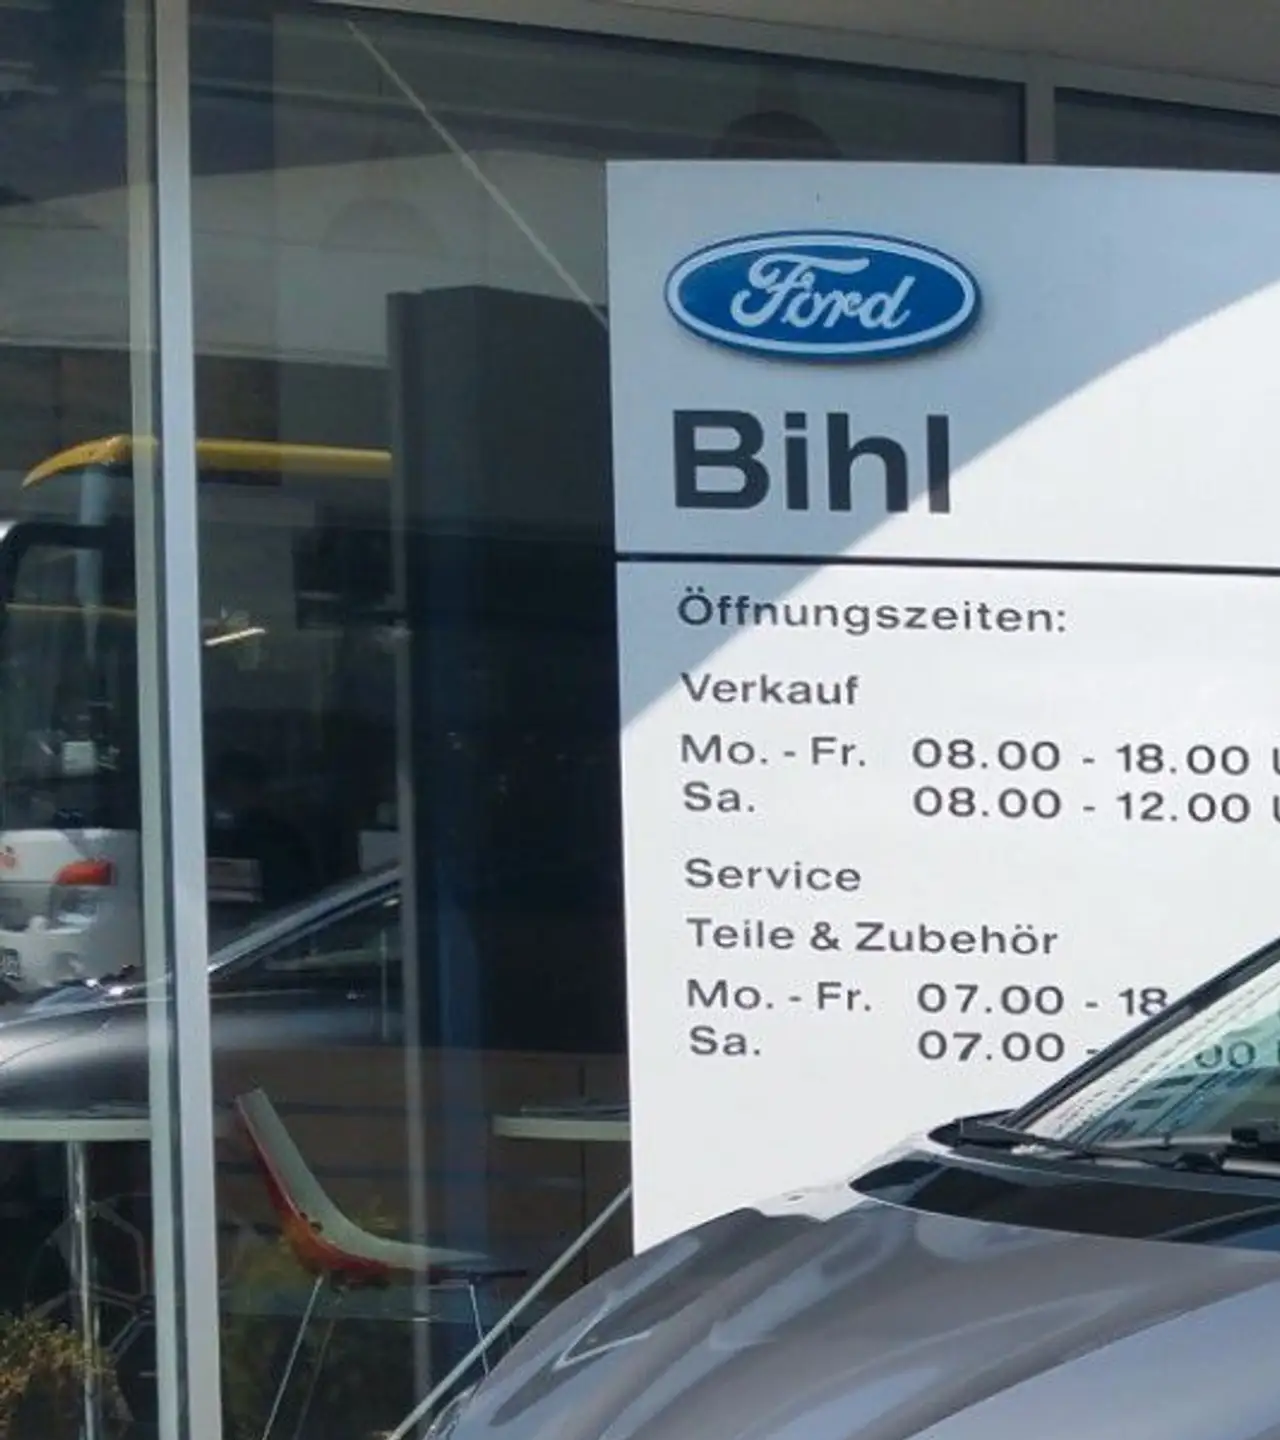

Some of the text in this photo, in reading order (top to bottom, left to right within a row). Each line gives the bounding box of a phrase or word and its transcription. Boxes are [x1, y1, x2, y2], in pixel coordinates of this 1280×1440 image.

[731, 251, 912, 333] Ford
[672, 409, 951, 514] Bihl
[677, 585, 1066, 637] Öffnungszeiten:
[680, 671, 859, 706] Verkauf
[681, 733, 769, 766] Mo.
[810, 735, 866, 767] Fr.
[911, 737, 1061, 772] 08.00
[1115, 742, 1251, 777] 18.00
[682, 780, 755, 814] Sa.
[912, 784, 1063, 820] 08.00
[1115, 790, 1252, 825] 12.00
[684, 857, 862, 893] Service
[685, 917, 1059, 956] Teile & Zubehör
[686, 978, 774, 1011] Mo.
[816, 980, 872, 1012] Fr.
[916, 981, 1065, 1016] 07.00
[689, 1024, 761, 1057] Sa.
[917, 1029, 1066, 1063] 07.00
